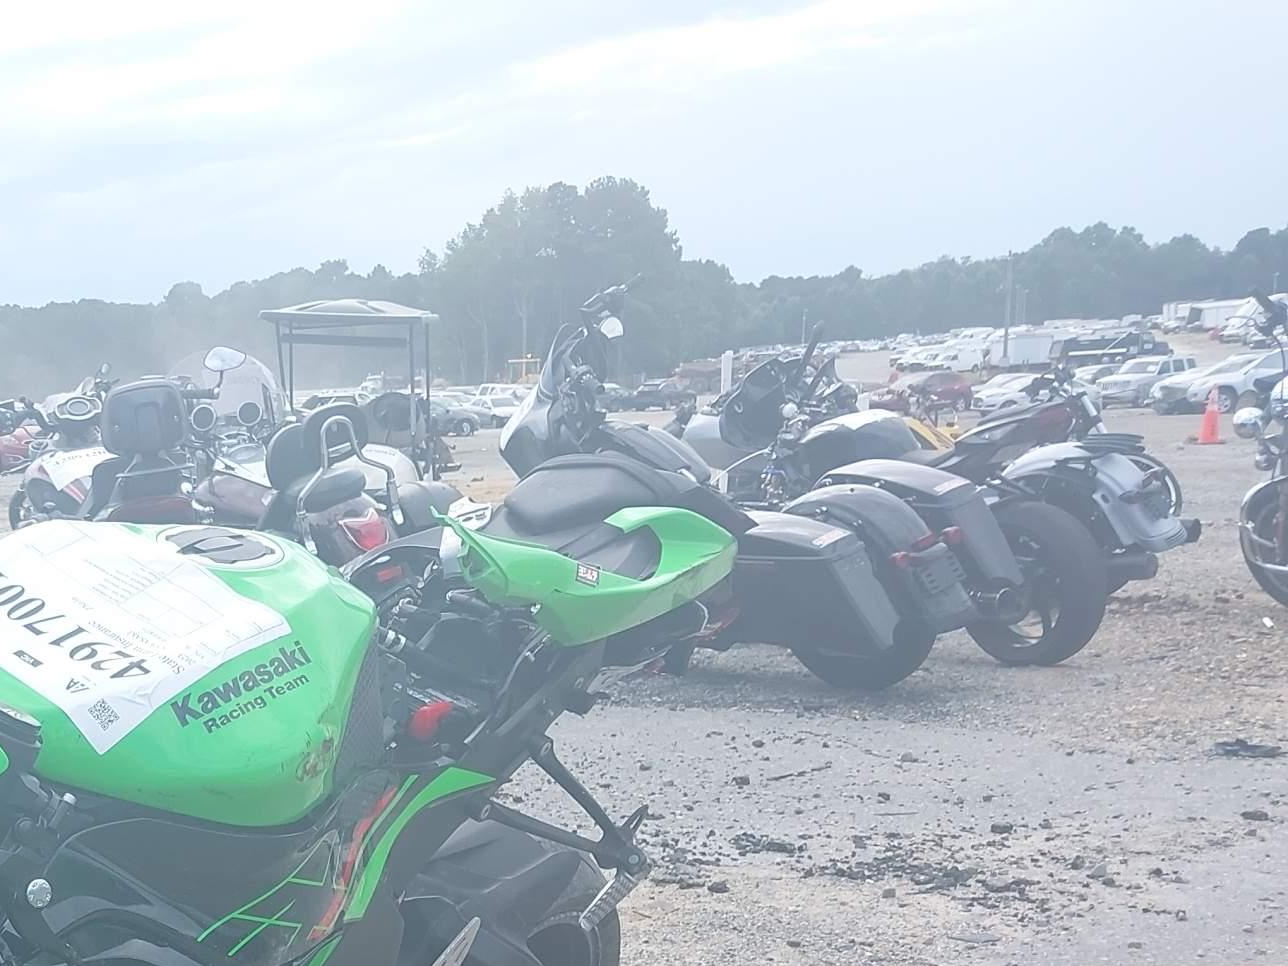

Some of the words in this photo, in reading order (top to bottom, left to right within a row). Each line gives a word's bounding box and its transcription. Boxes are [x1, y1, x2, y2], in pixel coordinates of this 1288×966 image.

[170, 640, 312, 727] Kawasaki
[202, 696, 267, 733] Racing
[264, 674, 310, 699] Team
